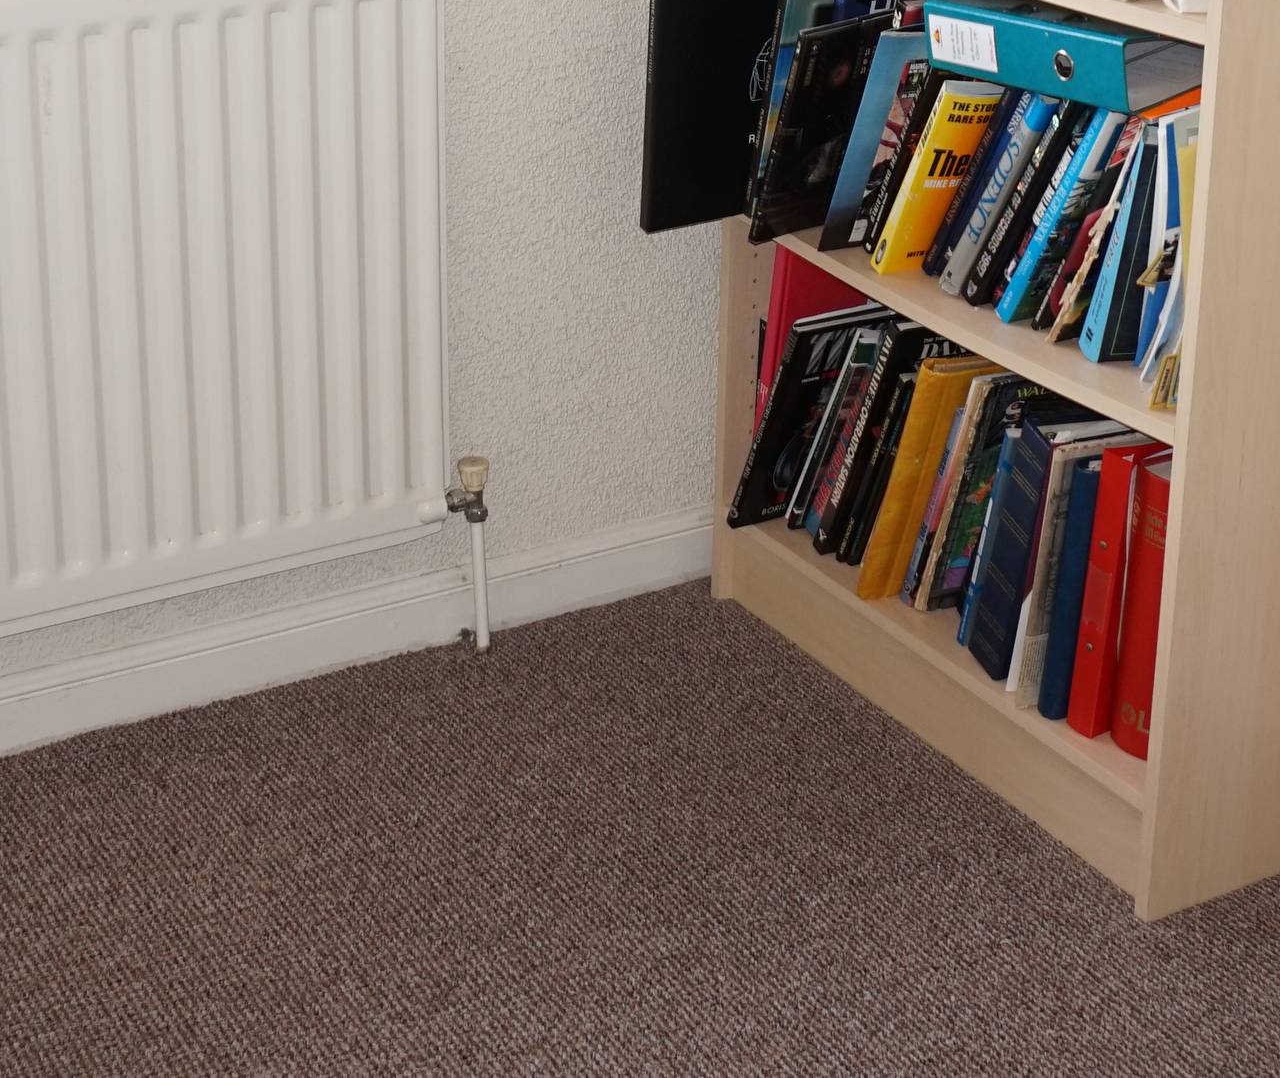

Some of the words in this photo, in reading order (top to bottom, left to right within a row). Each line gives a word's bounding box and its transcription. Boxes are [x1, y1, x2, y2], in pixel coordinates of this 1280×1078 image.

[948, 114, 973, 124] RARE
[952, 102, 972, 111] THE
[1008, 90, 1032, 136] SHARKS
[928, 149, 970, 176] The
[924, 179, 946, 188] MIKE
[968, 139, 1021, 244] SCIENCE
[1016, 164, 1036, 192] BOOK
[868, 168, 892, 223] UNEXPLAINED
[945, 194, 962, 224] DISNEY
[1008, 192, 1022, 209] OF
[988, 207, 1016, 252] RECORDS
[976, 251, 992, 277] 1997
[843, 406, 870, 466] OPERATION
[830, 466, 850, 508] SATURN
[761, 502, 786, 516] BORIS
